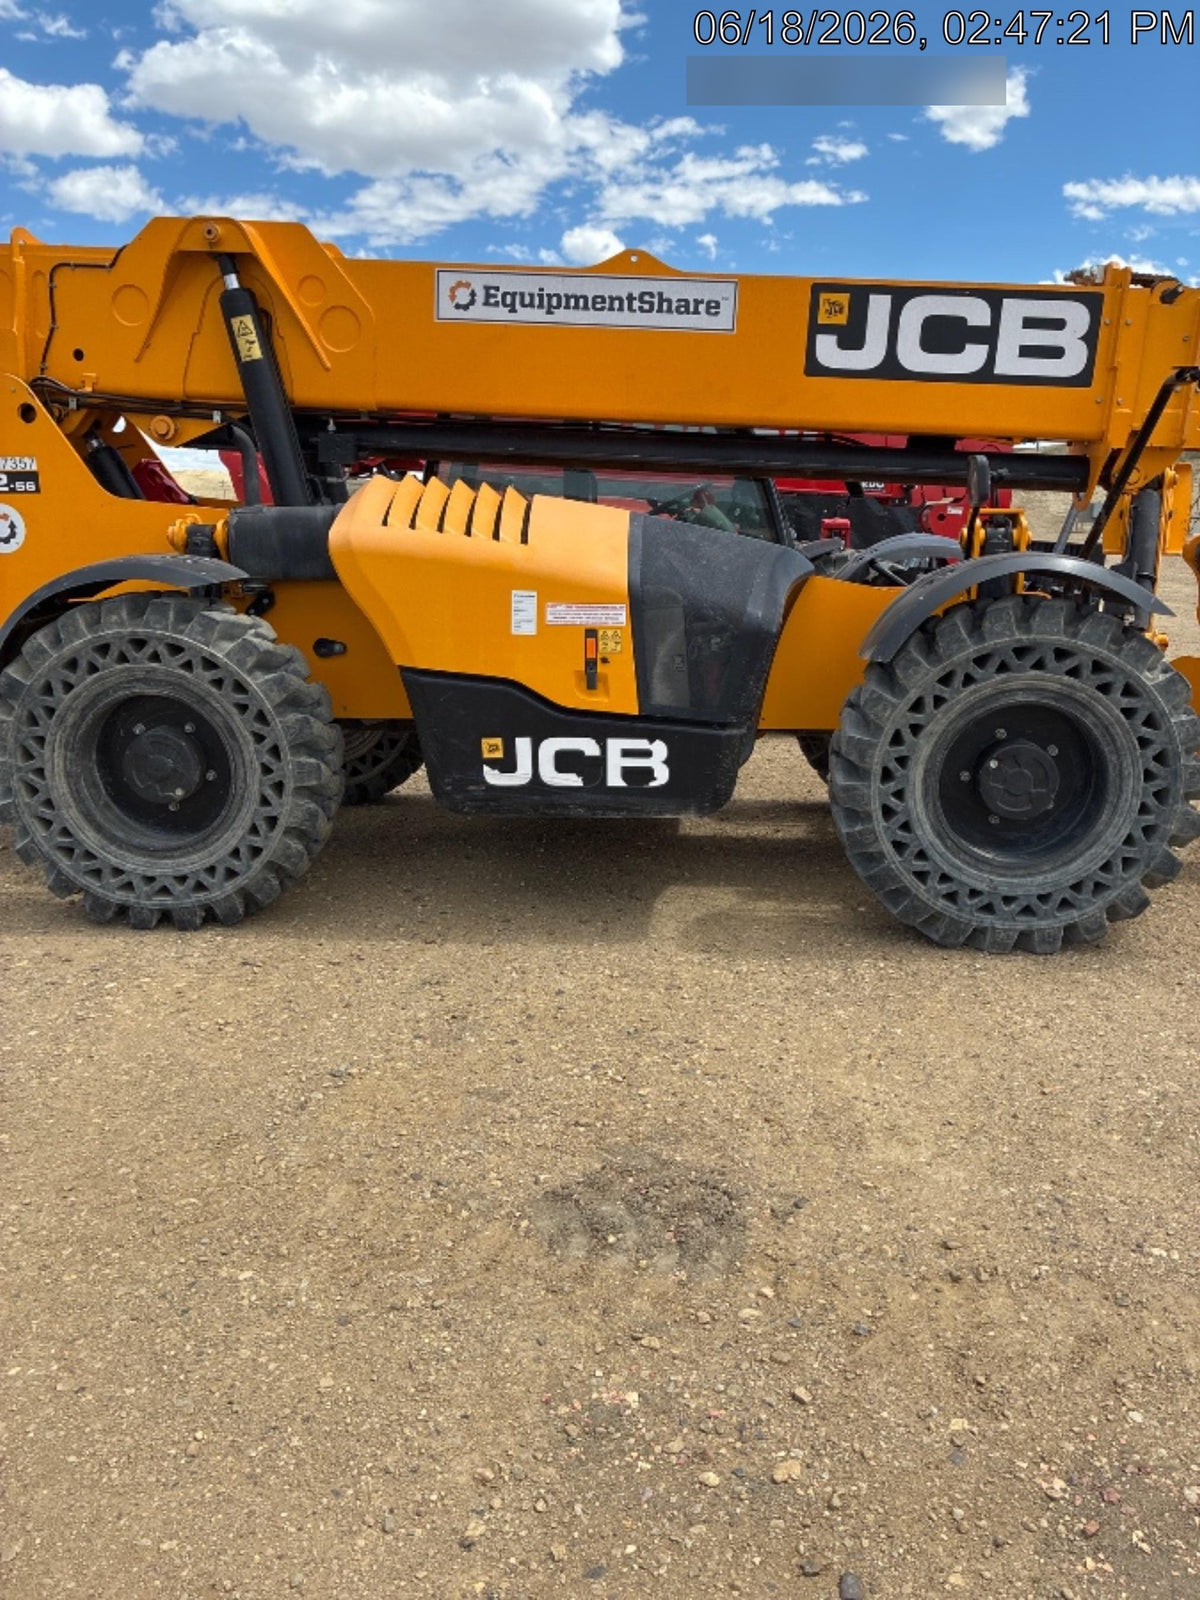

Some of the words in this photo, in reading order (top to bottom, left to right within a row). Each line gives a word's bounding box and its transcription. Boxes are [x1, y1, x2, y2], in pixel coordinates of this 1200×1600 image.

[482, 285, 721, 316] EquipmentShare
[815, 294, 1091, 377] JCB
[482, 737, 669, 786] JCB
